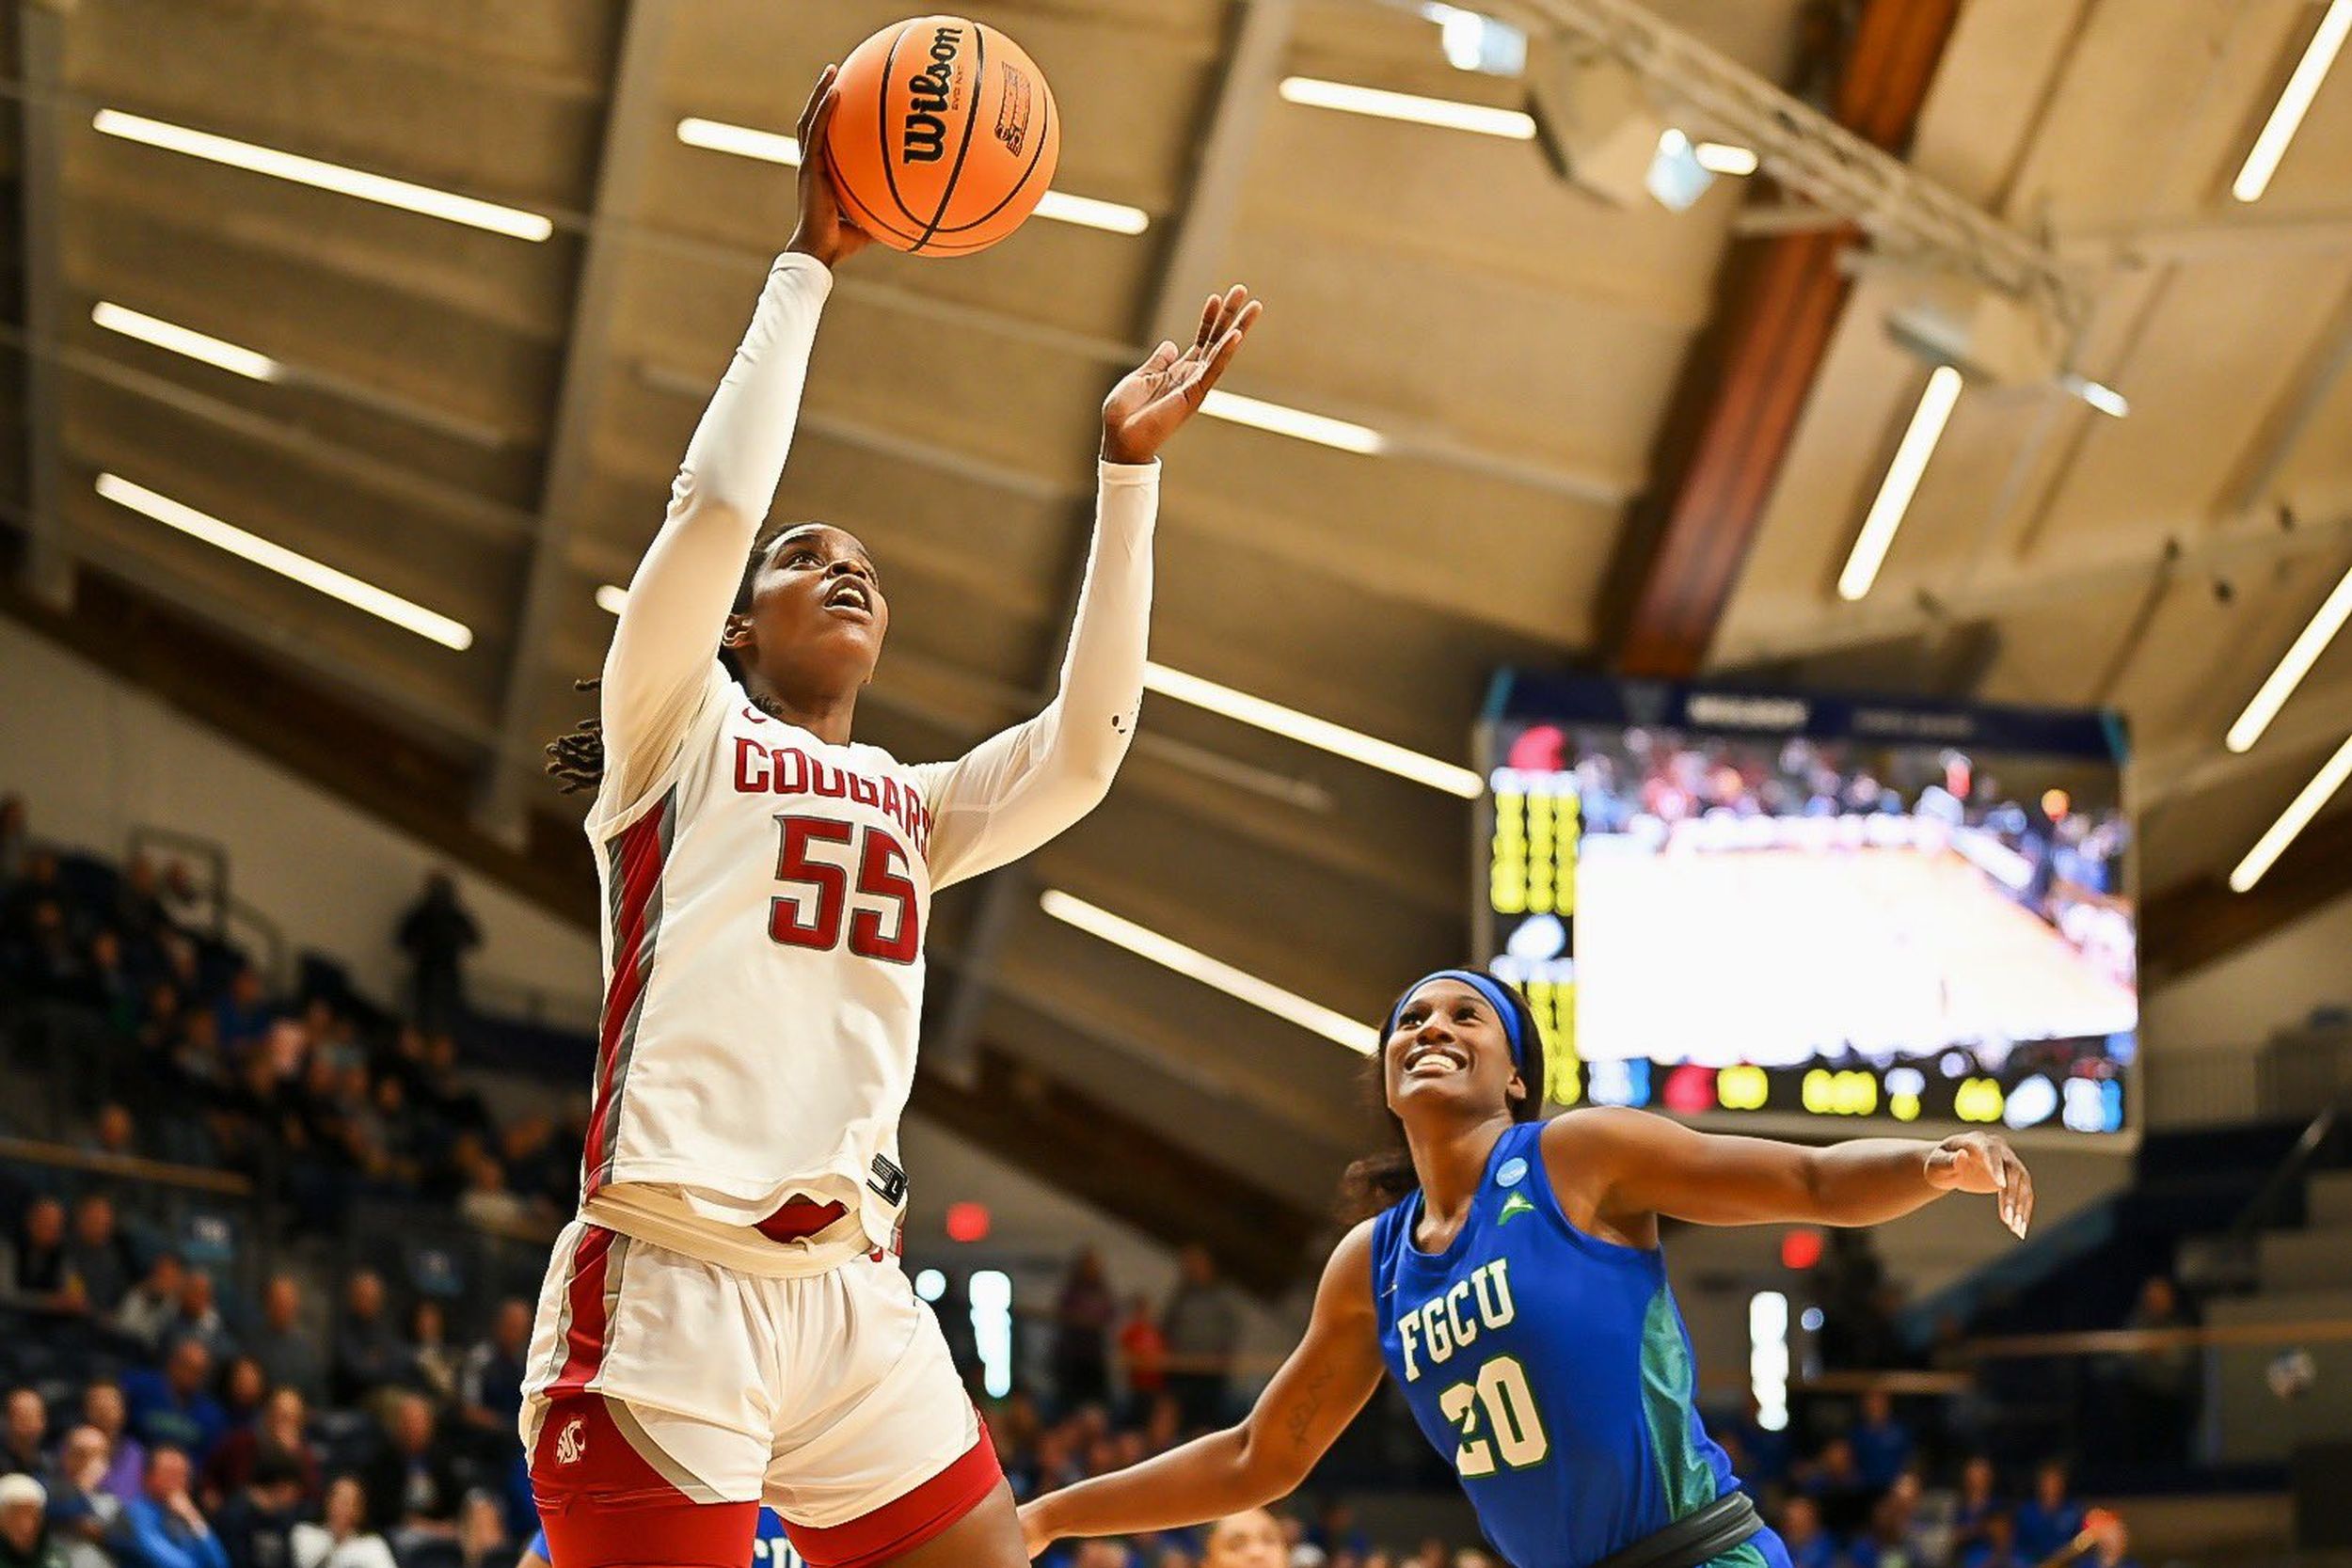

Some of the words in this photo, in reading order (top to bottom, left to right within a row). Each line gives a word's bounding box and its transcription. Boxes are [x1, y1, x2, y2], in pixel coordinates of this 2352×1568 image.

[904, 27, 962, 164] Wilson
[768, 815, 918, 965] 55
[1397, 1258, 1515, 1383] FGCU
[1439, 1354, 1549, 1477] 20
